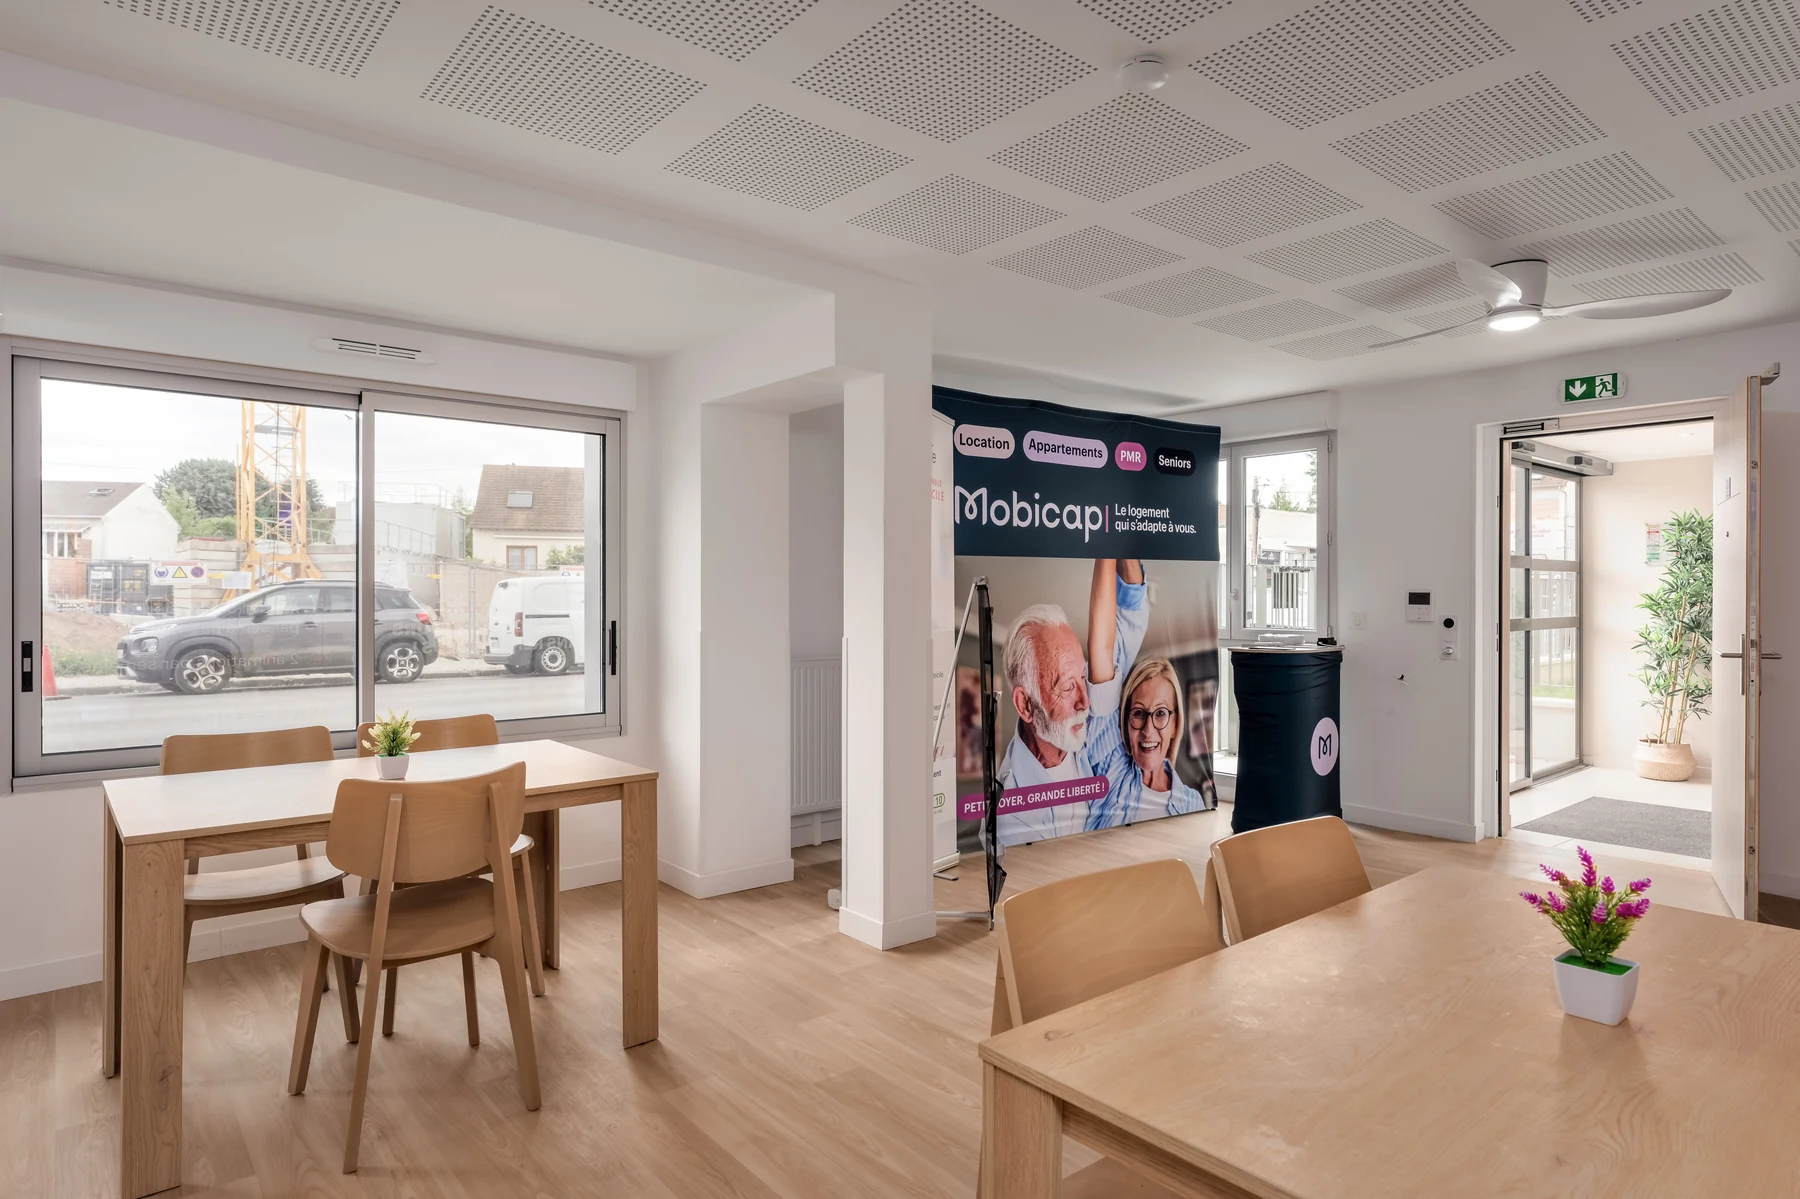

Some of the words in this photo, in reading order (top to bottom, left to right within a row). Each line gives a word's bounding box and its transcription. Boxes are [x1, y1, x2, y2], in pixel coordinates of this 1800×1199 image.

[959, 433, 1010, 450] Location
[1028, 438, 1103, 459] Appartements
[1120, 450, 1141, 463] PMR
[1158, 455, 1191, 469] Seniors
[954, 485, 1103, 543] Mobicap
[1115, 504, 1127, 516] Le
[1128, 504, 1170, 519] logement
[1115, 520, 1129, 533] qui
[1130, 519, 1167, 534] s'adapte
[1168, 521, 1174, 532] à
[1175, 523, 1197, 534] vous.
[997, 795, 1026, 809] OYER,
[1027, 788, 1066, 804] GRANDE
[1067, 781, 1101, 798] LIBERTÉ
